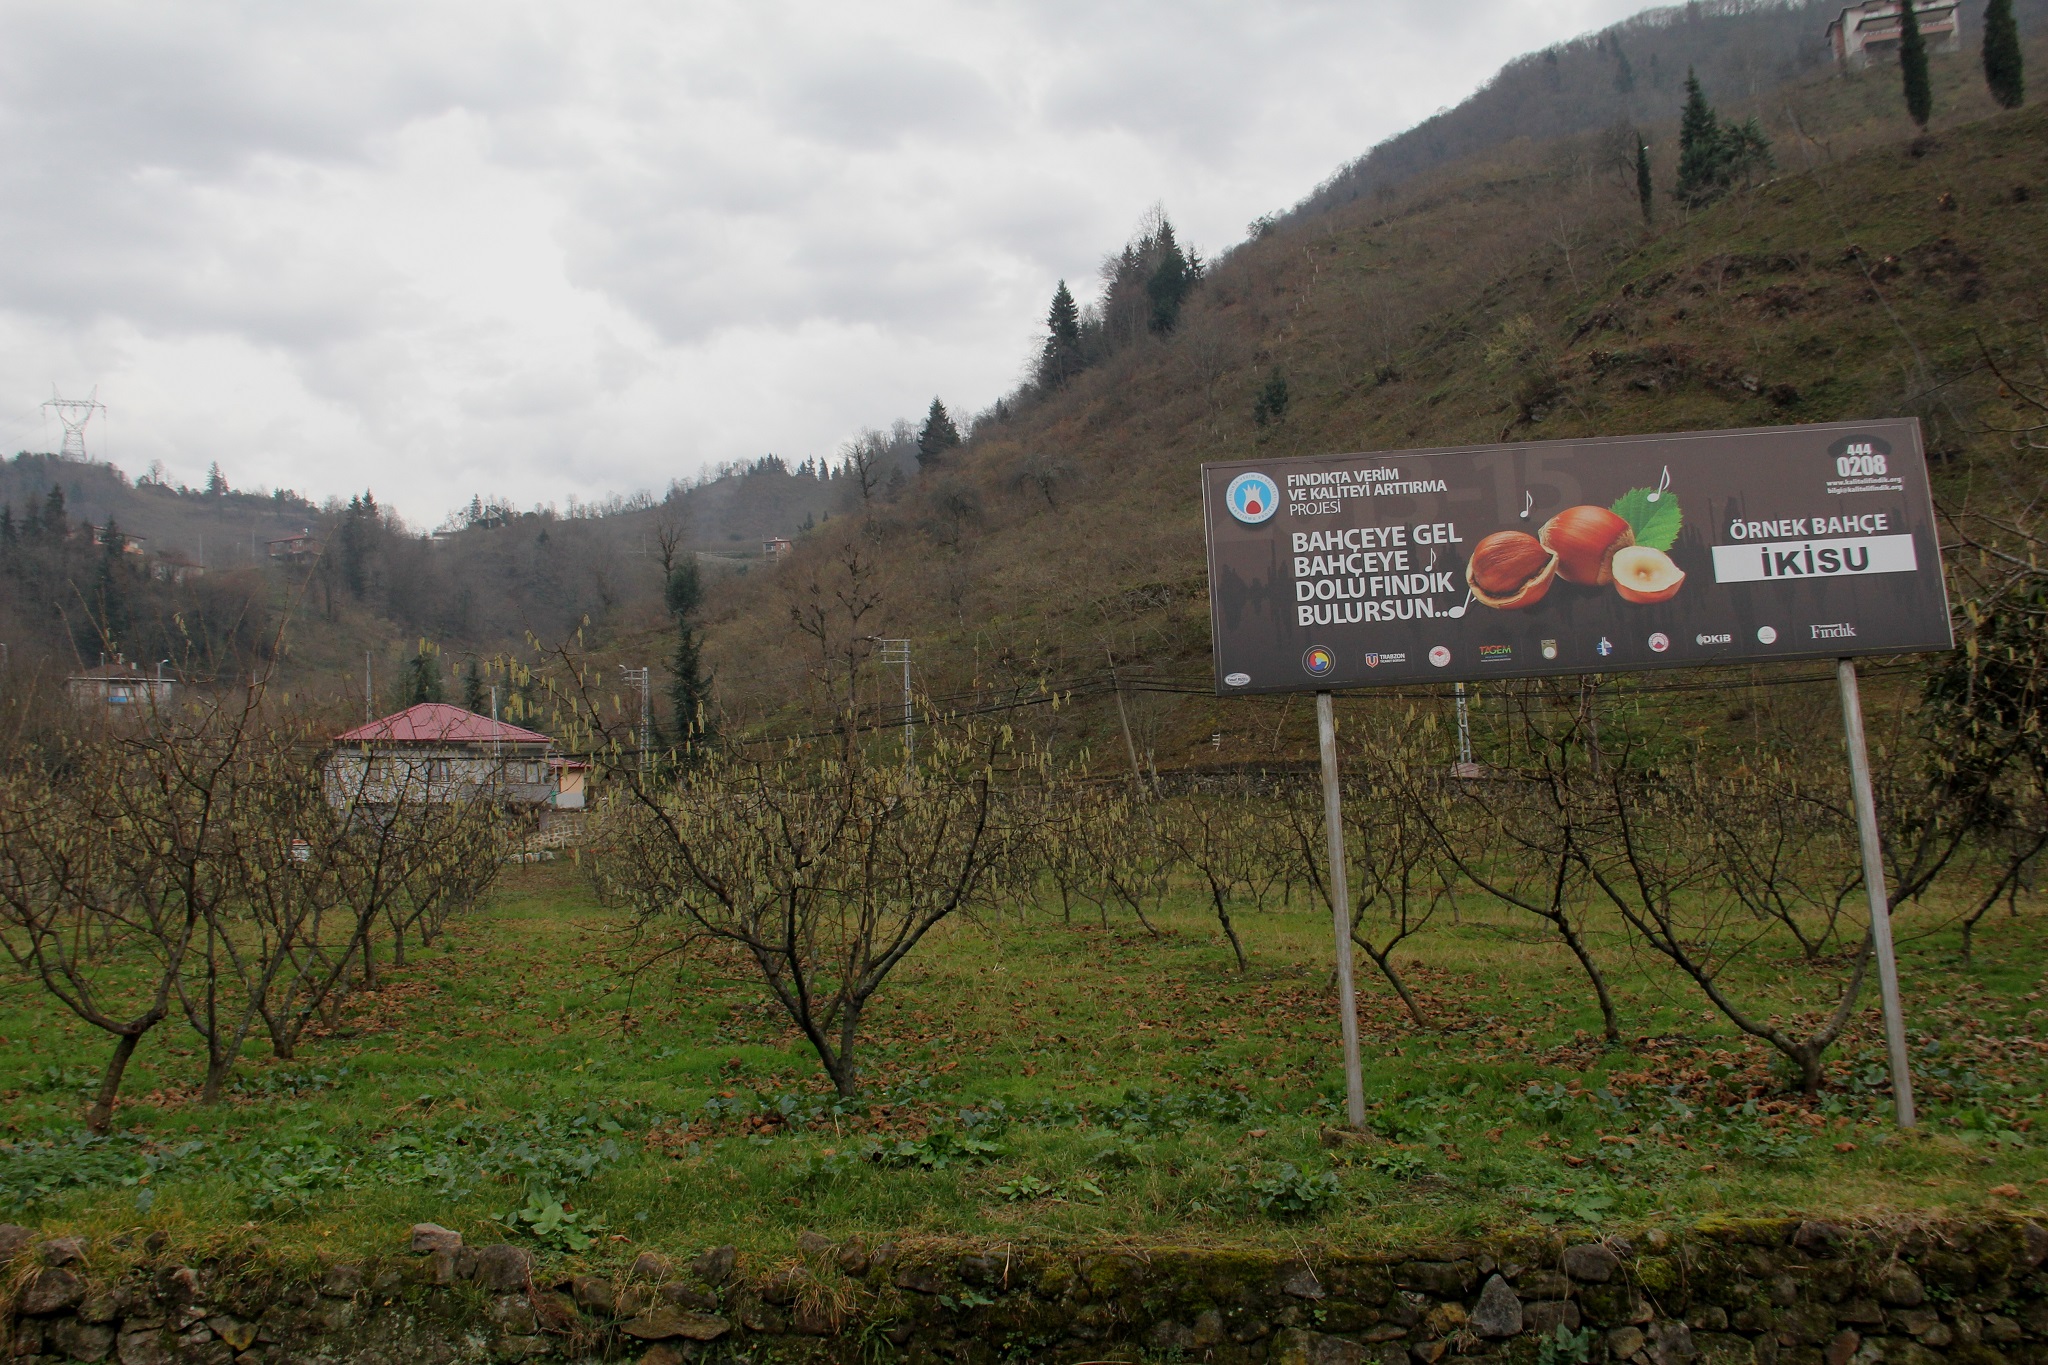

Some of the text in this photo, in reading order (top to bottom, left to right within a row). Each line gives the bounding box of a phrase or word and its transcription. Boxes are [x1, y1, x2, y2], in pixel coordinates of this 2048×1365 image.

[1847, 443, 1872, 456] 444
[1287, 466, 1399, 487] FINDIKTA VERİM
[1836, 454, 1887, 477] 0208
[1288, 479, 1447, 501] VE KALİTEYİ ARTTIRMA
[1290, 498, 1341, 516] PROJESİ
[1292, 522, 1463, 553] BAHÇEYE GEL
[1729, 513, 1889, 540] ÖRNEK BAHÇE
[1293, 550, 1410, 578] BAHÇEYE
[1760, 544, 1870, 577] İKİSU
[1295, 571, 1455, 602] DOLU FINDIK
[1479, 645, 1512, 655] TAGEM
